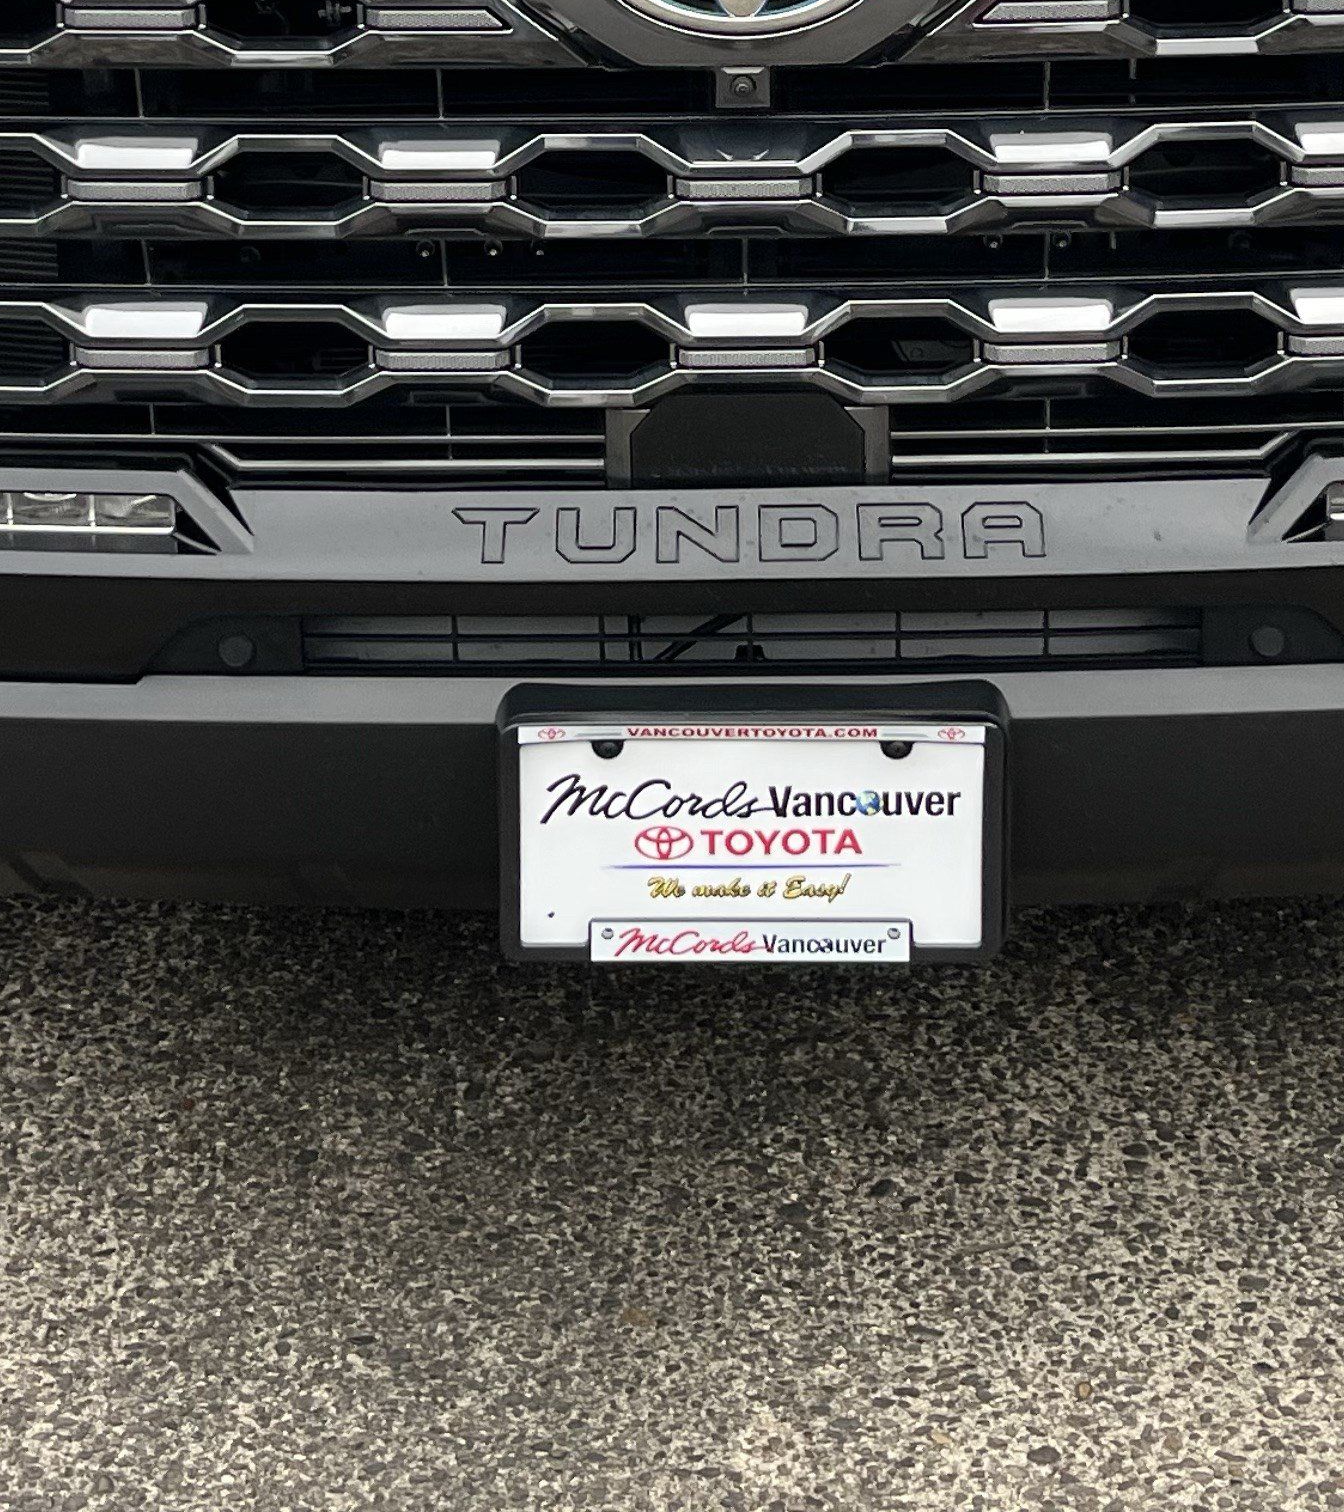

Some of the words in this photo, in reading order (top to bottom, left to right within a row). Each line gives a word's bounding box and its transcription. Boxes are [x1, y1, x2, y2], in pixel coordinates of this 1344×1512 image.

[452, 502, 1047, 565] TUNDRA
[626, 727, 878, 738] VANCOUVERTOYOTA.COM
[539, 773, 760, 825] McCords
[768, 785, 962, 818] Vancouver
[699, 828, 863, 856] TOYOTA
[647, 876, 686, 899] We
[691, 877, 751, 899] make
[756, 880, 778, 898] it
[782, 872, 853, 904] Easy!
[614, 927, 759, 957] McCords
[761, 933, 887, 955] Vancouver
